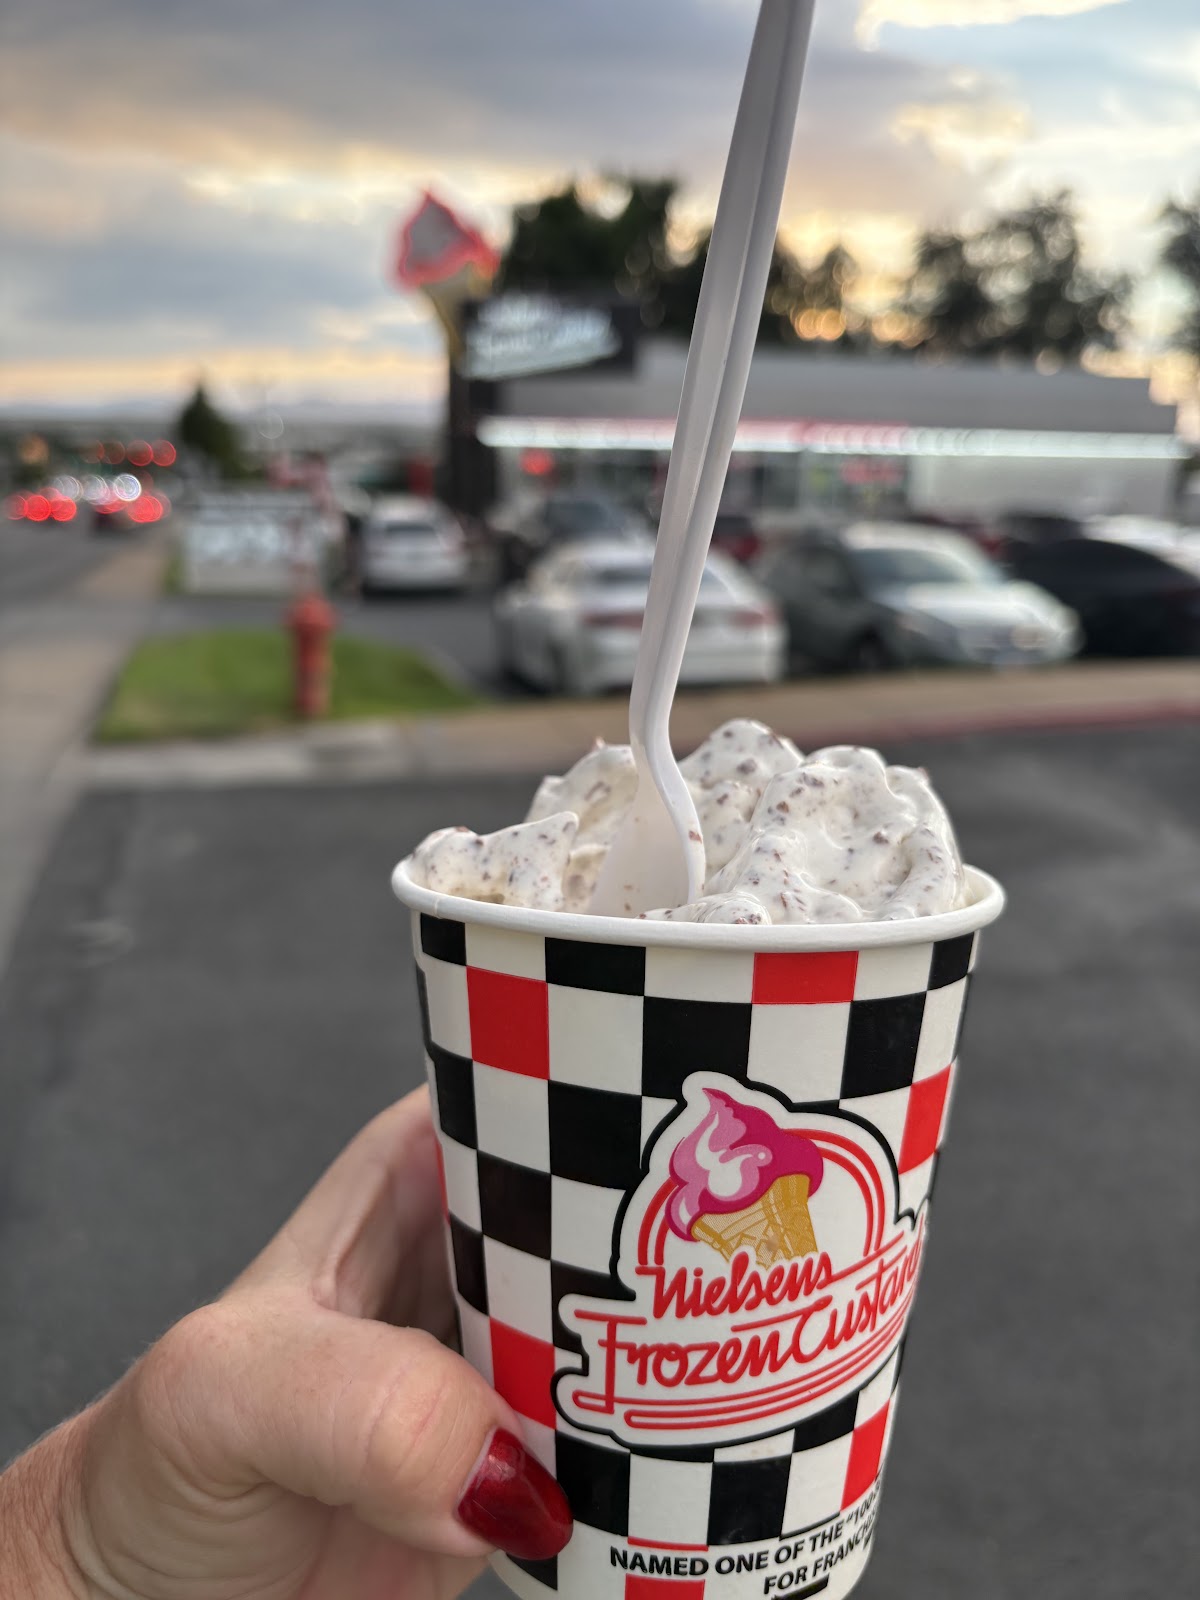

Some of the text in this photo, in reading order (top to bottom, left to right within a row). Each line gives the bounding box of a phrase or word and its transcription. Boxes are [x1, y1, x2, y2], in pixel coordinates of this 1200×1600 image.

[635, 1251, 834, 1319] Nielsens
[573, 1309, 790, 1413] Frozen
[610, 1546, 709, 1576] NAMED
[715, 1550, 769, 1574] ONE
[774, 1539, 804, 1564] OF
[809, 1519, 844, 1552] THE
[764, 1566, 807, 1595] FOR
